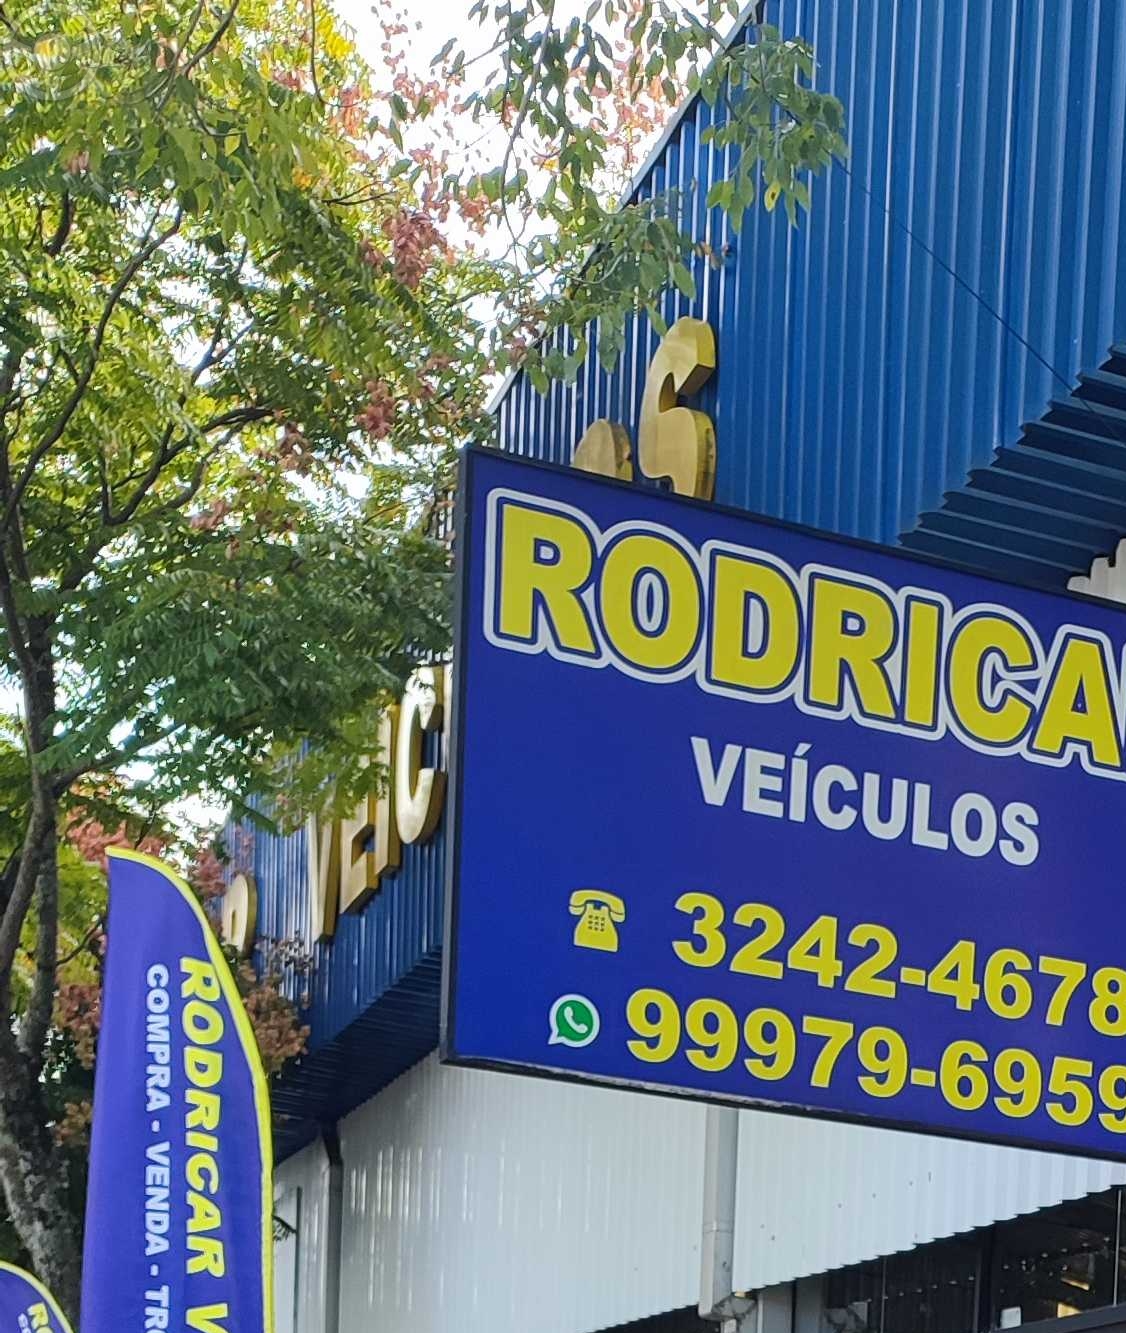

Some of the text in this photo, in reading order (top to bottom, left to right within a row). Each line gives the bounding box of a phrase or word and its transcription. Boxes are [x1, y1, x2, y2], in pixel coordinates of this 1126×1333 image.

[690, 736, 1040, 866] VEÍCULOS
[145, 963, 172, 1112] COMPRA
[180, 956, 226, 1279] RODRICAR
[144, 1140, 172, 1256] VENDA
